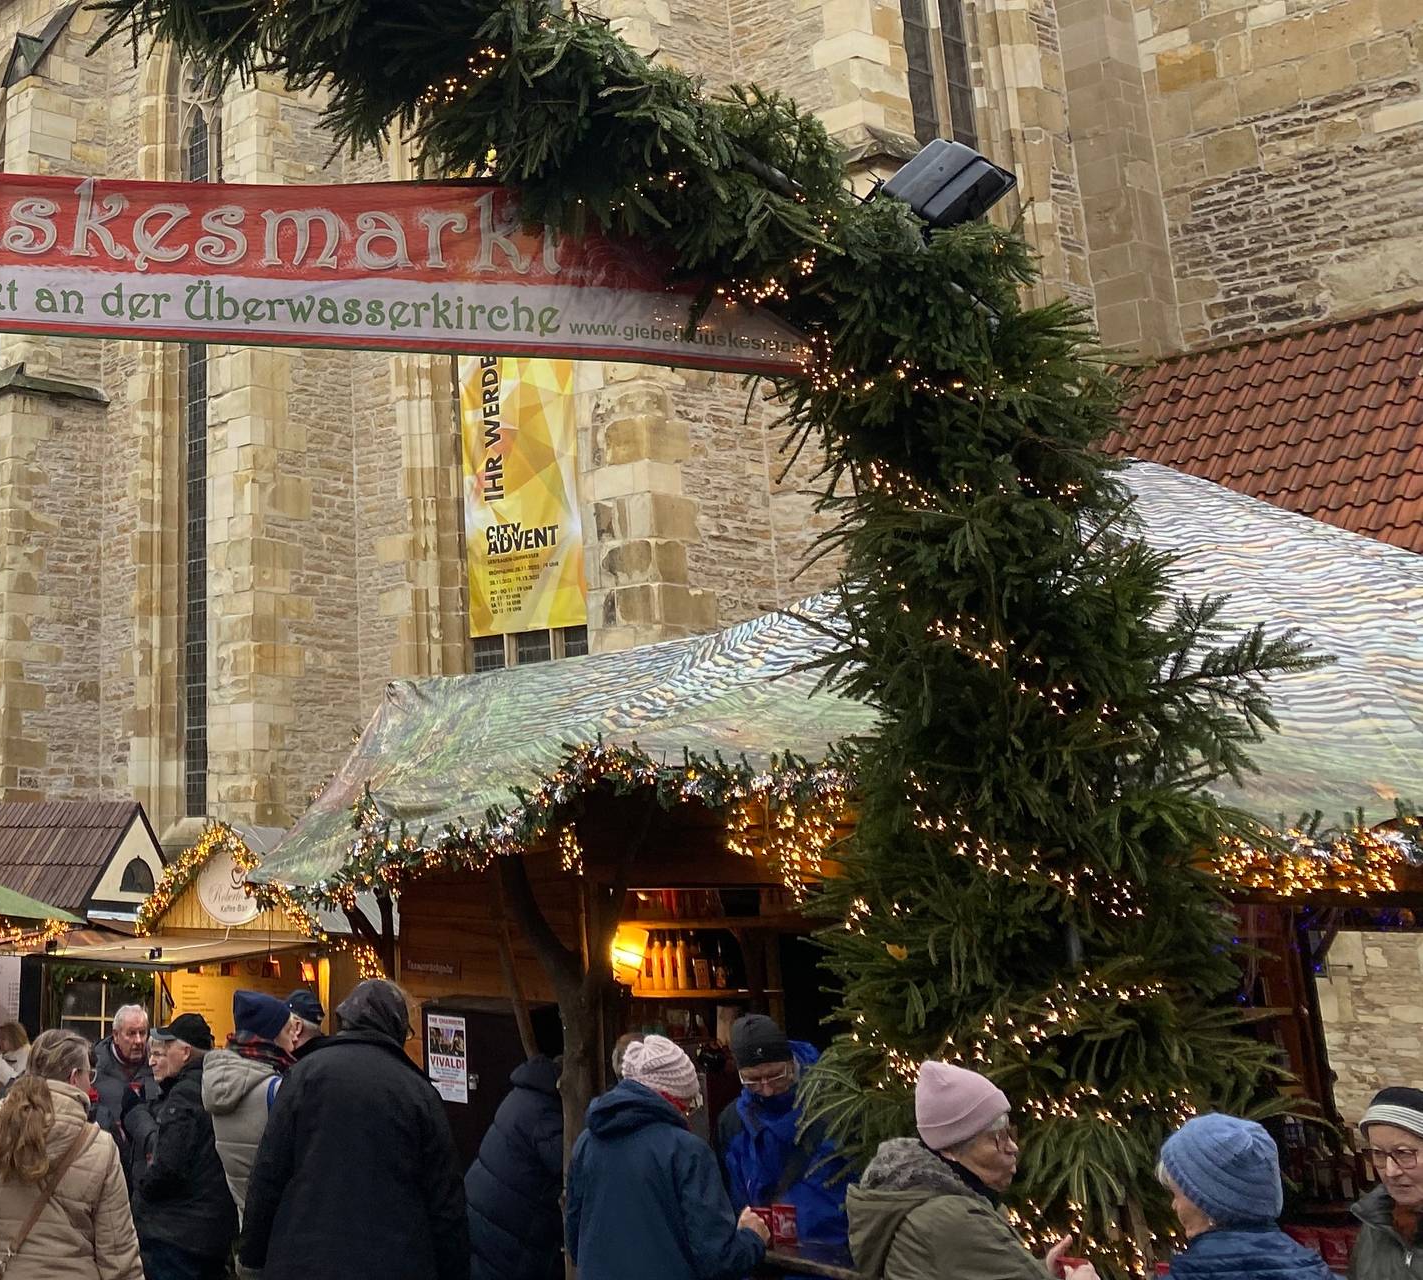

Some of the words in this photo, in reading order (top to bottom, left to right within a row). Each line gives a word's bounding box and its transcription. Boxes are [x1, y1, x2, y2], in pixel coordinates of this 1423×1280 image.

[34, 285, 85, 316] an
[100, 282, 172, 322] der
[184, 279, 562, 337] Überwasserkirche
[484, 454, 505, 501] IHR
[486, 522, 521, 543] CITY
[487, 524, 559, 555] ADVENT
[430, 1055, 465, 1071] VIVALDI
